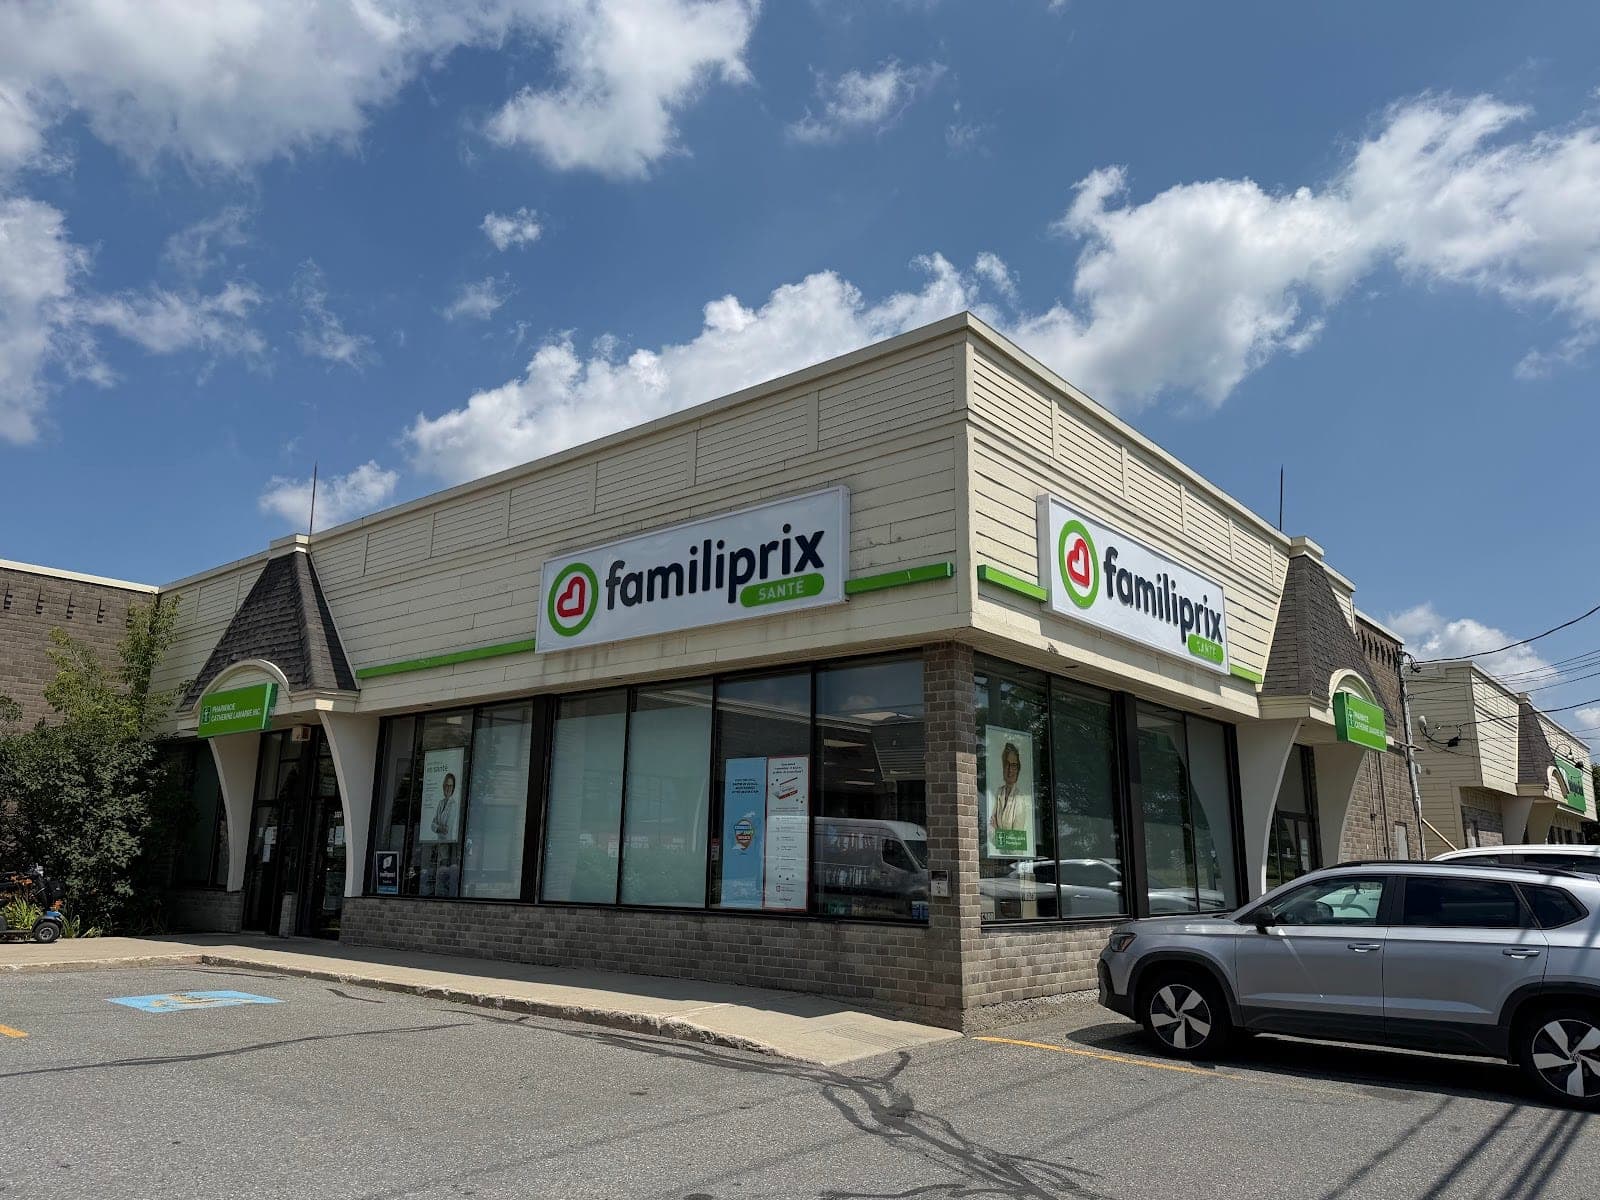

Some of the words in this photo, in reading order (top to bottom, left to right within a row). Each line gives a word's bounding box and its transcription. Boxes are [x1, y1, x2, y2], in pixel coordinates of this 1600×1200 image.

[606, 523, 825, 610] familiprix
[758, 577, 805, 601] SANTÉ
[1103, 546, 1223, 645] familiprix
